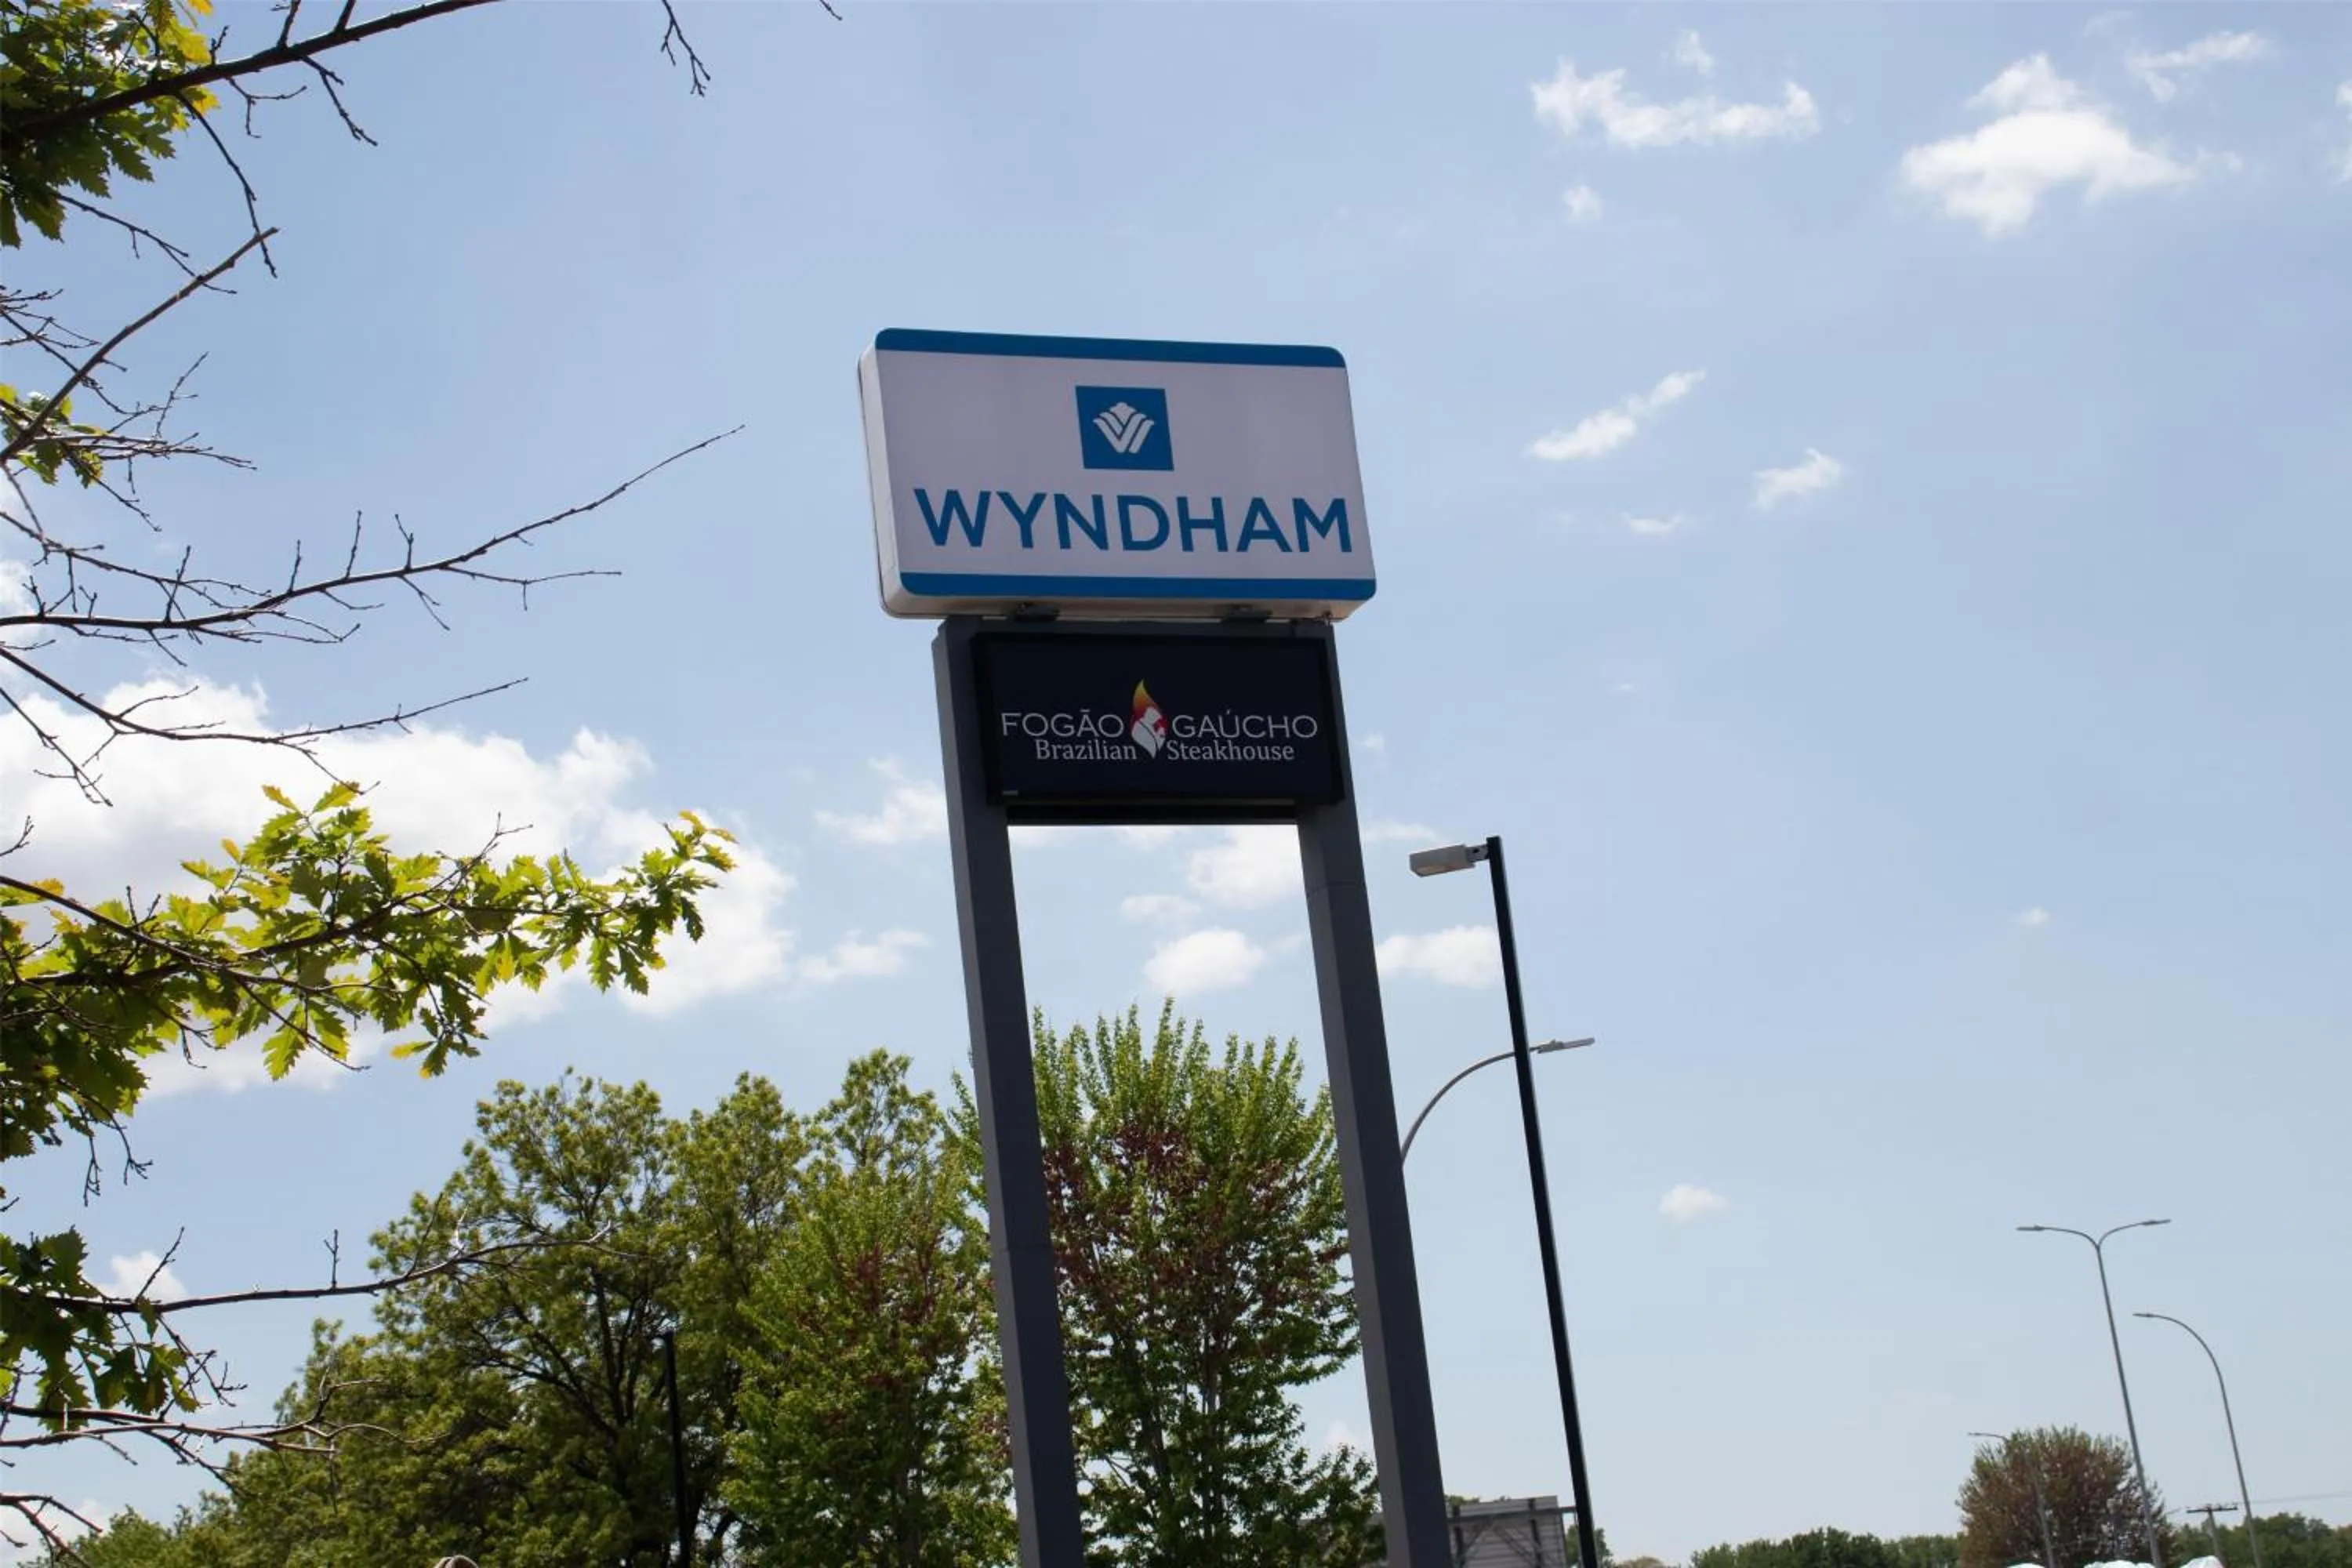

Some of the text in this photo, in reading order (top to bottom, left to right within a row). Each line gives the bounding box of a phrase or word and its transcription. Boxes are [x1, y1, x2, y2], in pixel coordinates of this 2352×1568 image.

[914, 488, 1352, 553] WYNDHAM
[1001, 709, 1318, 739] FOGÃO GAÚCHO
[1035, 739, 1294, 760] Brazilian Steakhouse
